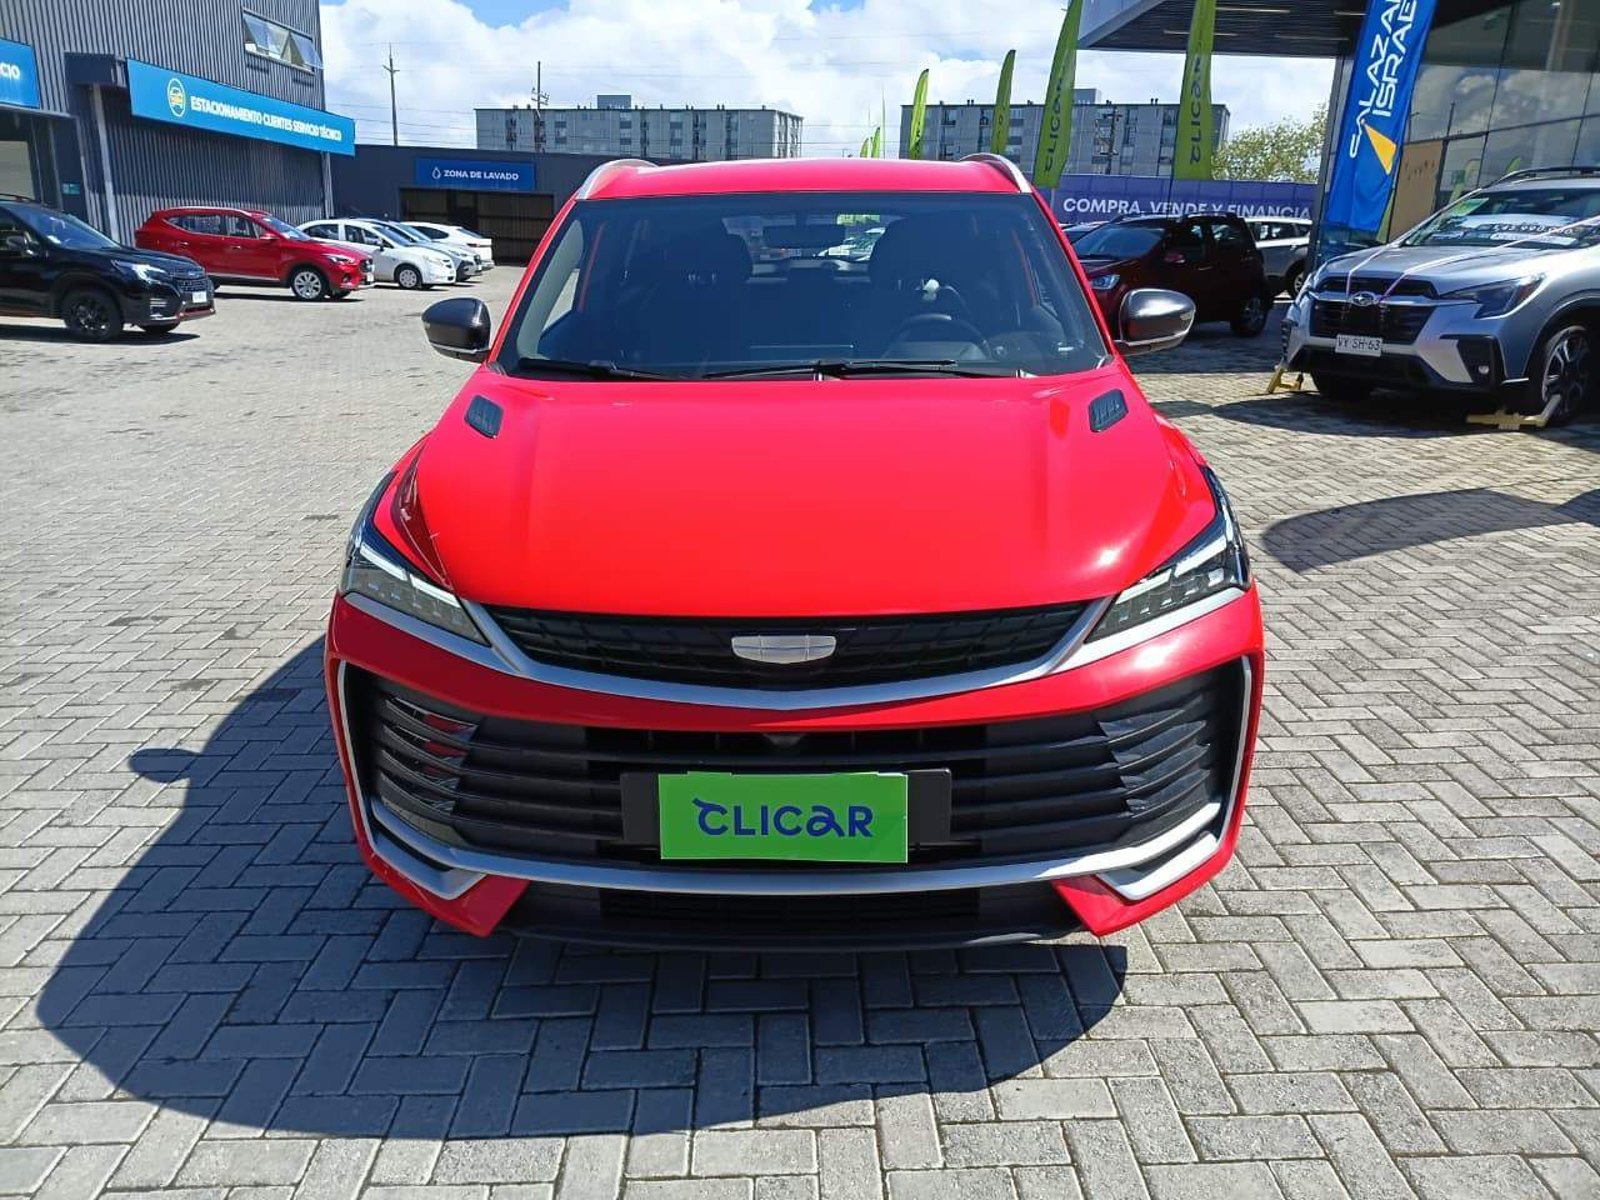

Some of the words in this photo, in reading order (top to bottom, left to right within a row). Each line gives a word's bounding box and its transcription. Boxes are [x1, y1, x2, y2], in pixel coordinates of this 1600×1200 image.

[1350, 0, 1400, 158] SALAZA
[190, 96, 262, 124] ESTACIONAMIENTO
[263, 112, 292, 132] CLIENTES
[293, 119, 318, 137] SERVICIO
[443, 169, 468, 178] ZONA
[469, 171, 482, 179] DE
[483, 171, 519, 181] LAVADO
